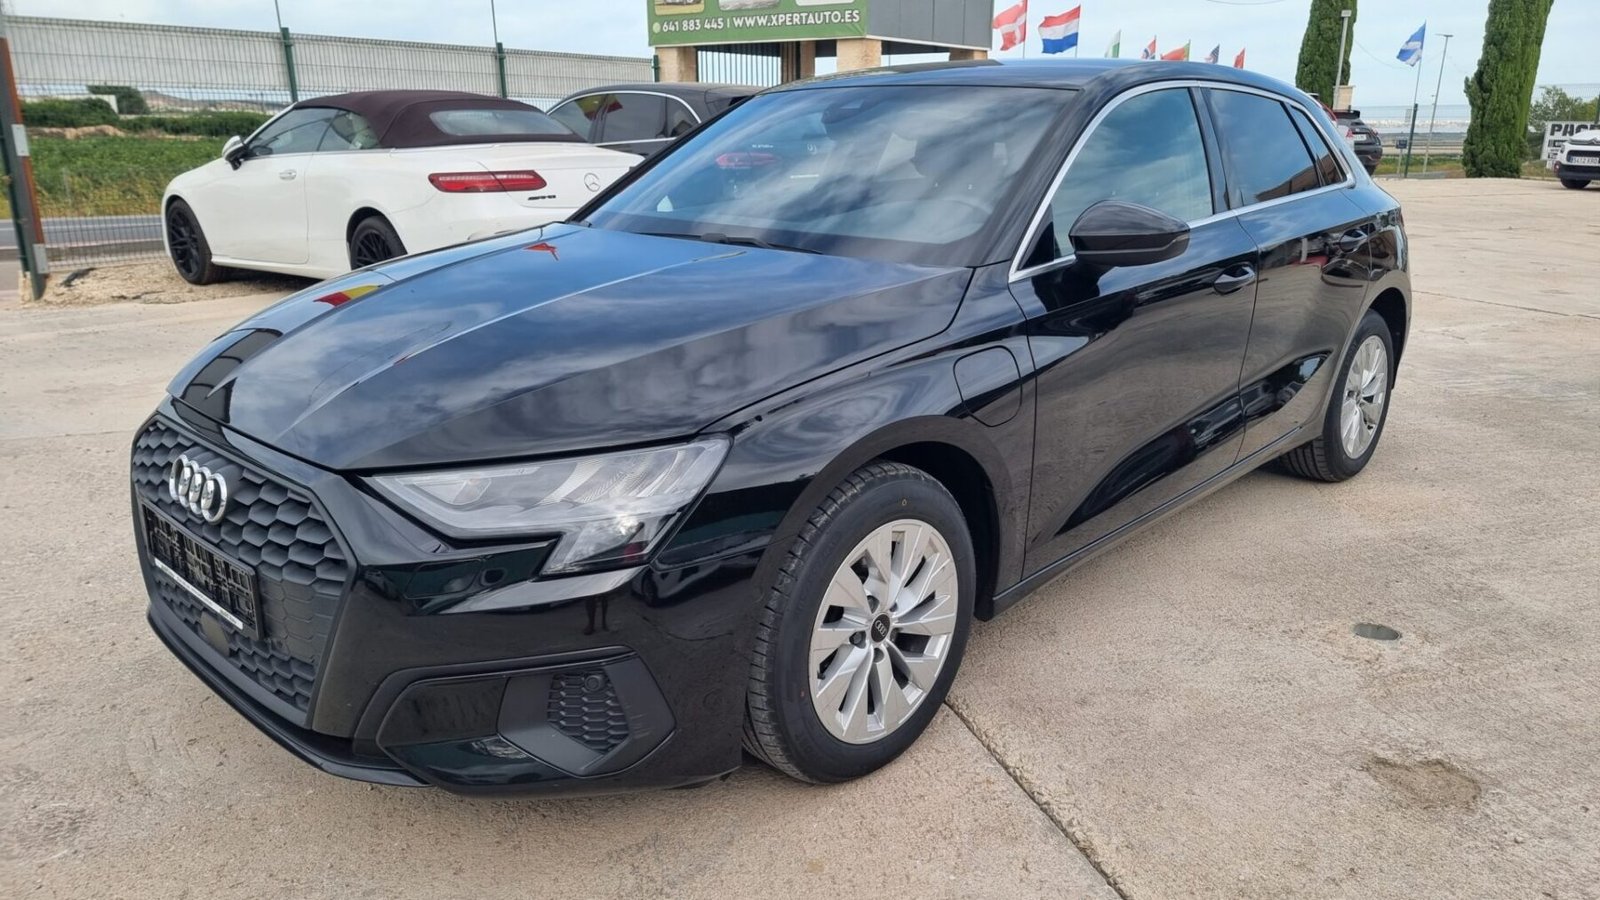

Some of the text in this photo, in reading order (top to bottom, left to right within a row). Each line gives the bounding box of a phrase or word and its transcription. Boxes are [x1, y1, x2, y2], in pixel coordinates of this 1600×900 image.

[662, 21, 679, 32] 641
[682, 19, 700, 31] 883
[704, 18, 724, 29] 445
[733, 10, 860, 27] WWW.XPERTAUTO.ES
